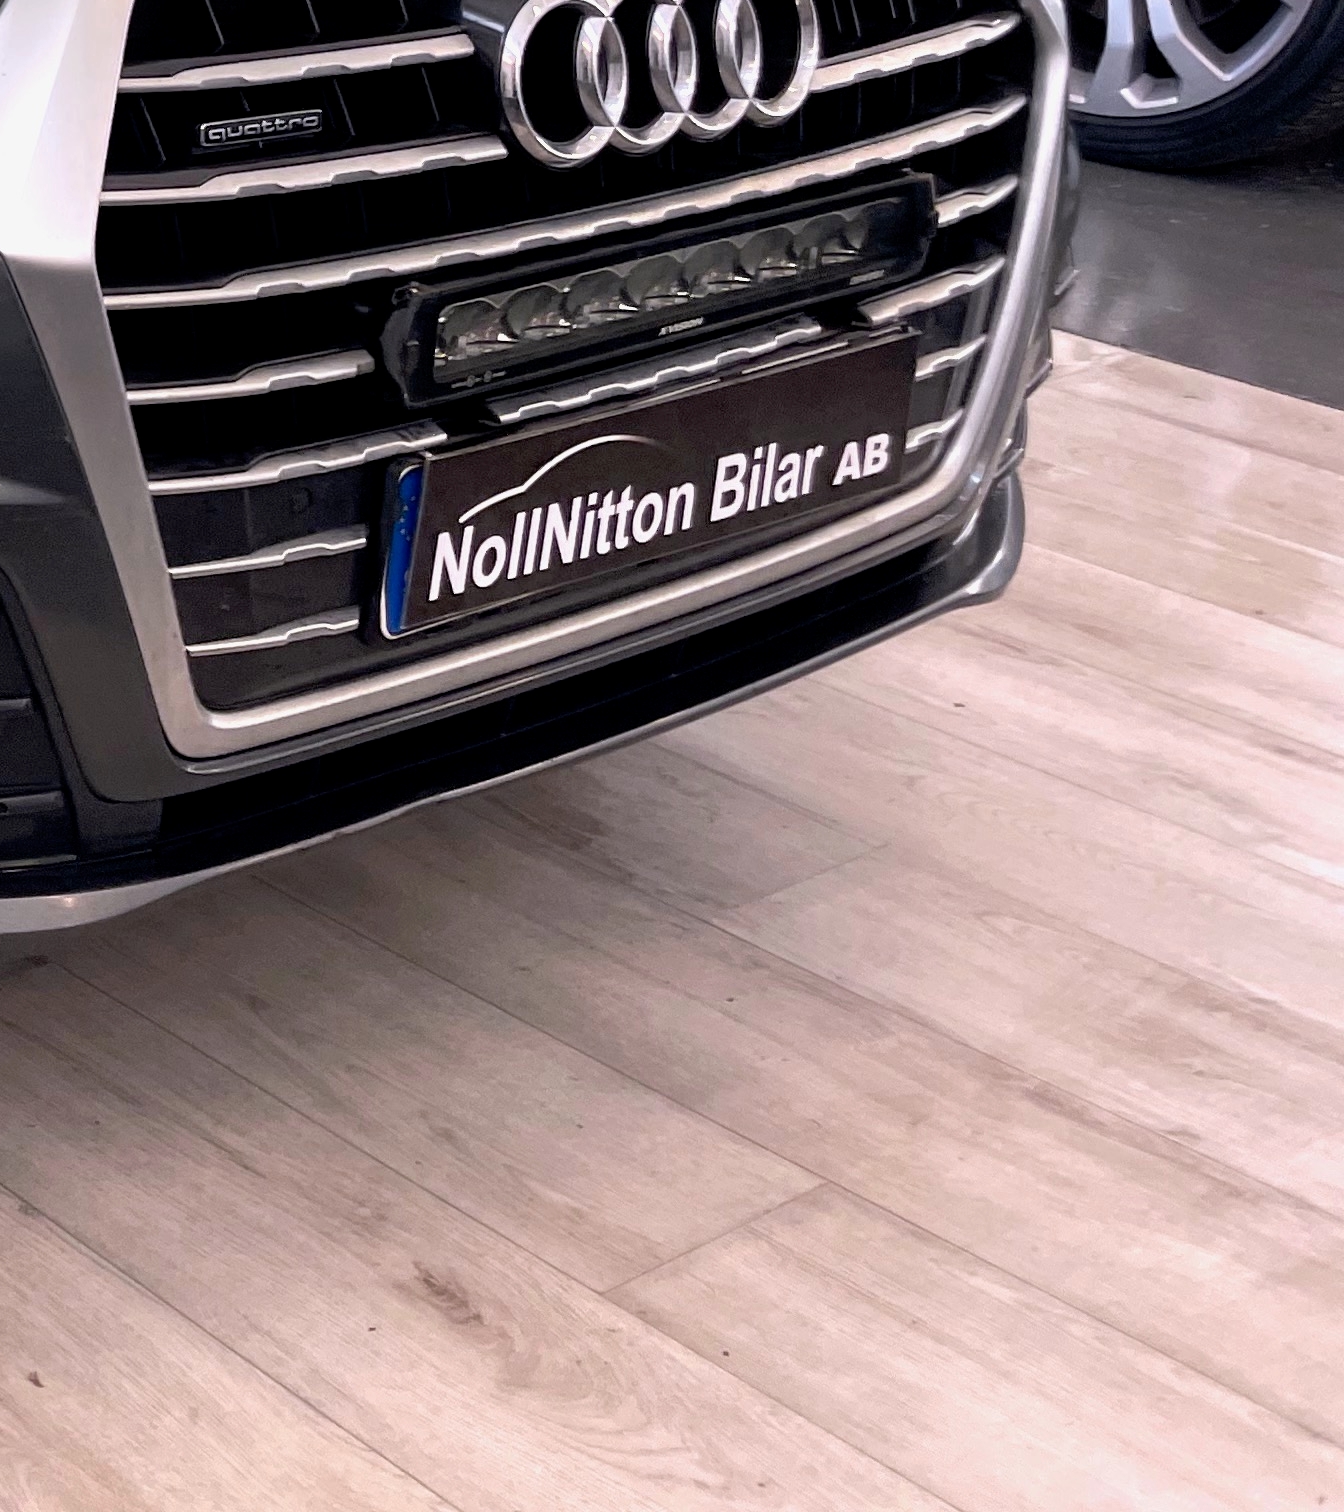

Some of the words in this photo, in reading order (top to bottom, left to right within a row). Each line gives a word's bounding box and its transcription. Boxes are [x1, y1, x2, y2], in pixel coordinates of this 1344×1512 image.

[208, 116, 319, 141] quattro
[428, 481, 695, 602] NollNitton
[710, 441, 825, 522] Bilar
[832, 433, 891, 486] AB
